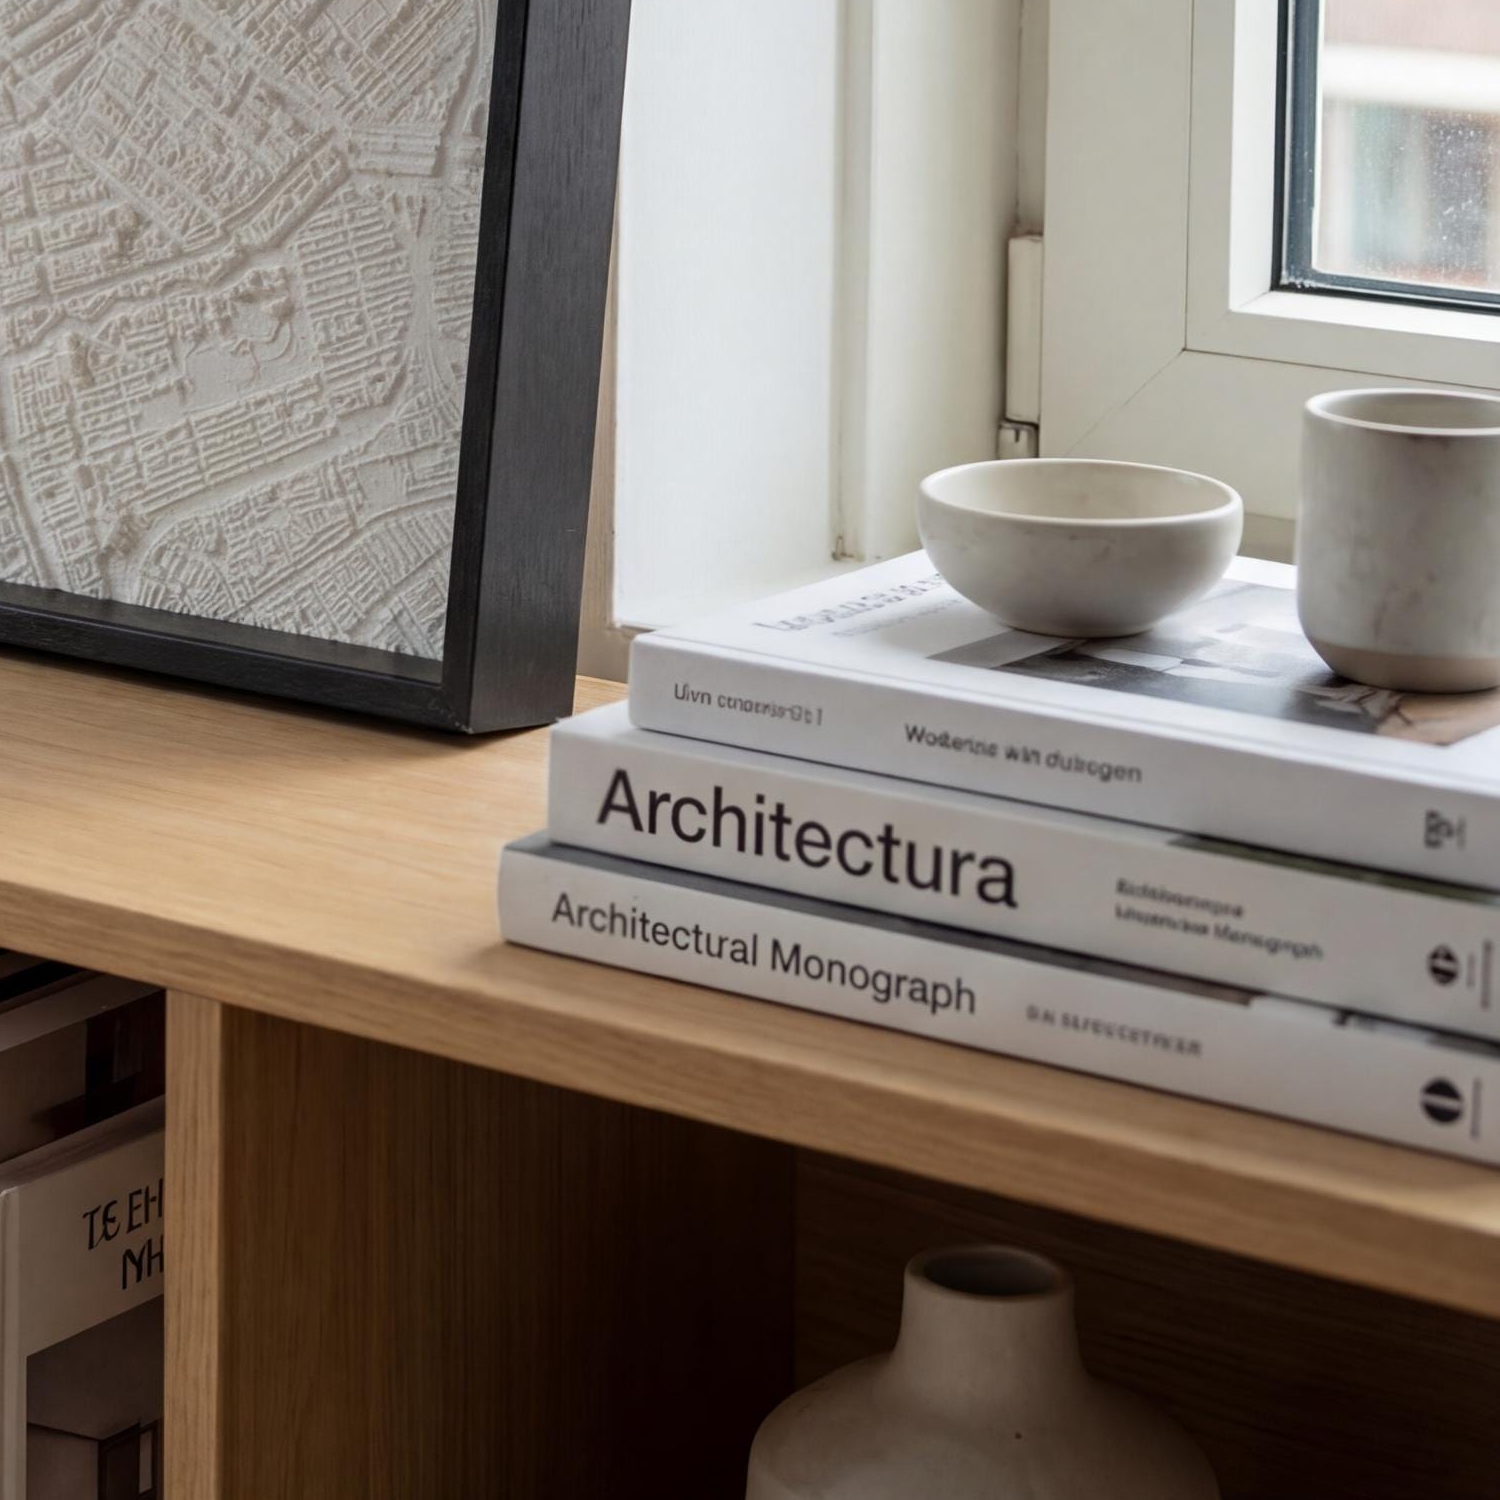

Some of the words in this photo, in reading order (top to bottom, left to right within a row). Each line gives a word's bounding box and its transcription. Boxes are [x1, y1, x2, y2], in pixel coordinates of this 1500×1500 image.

[596, 768, 1019, 910] Architectura
[551, 892, 759, 967] Architectural
[771, 938, 977, 1016] Monograph
